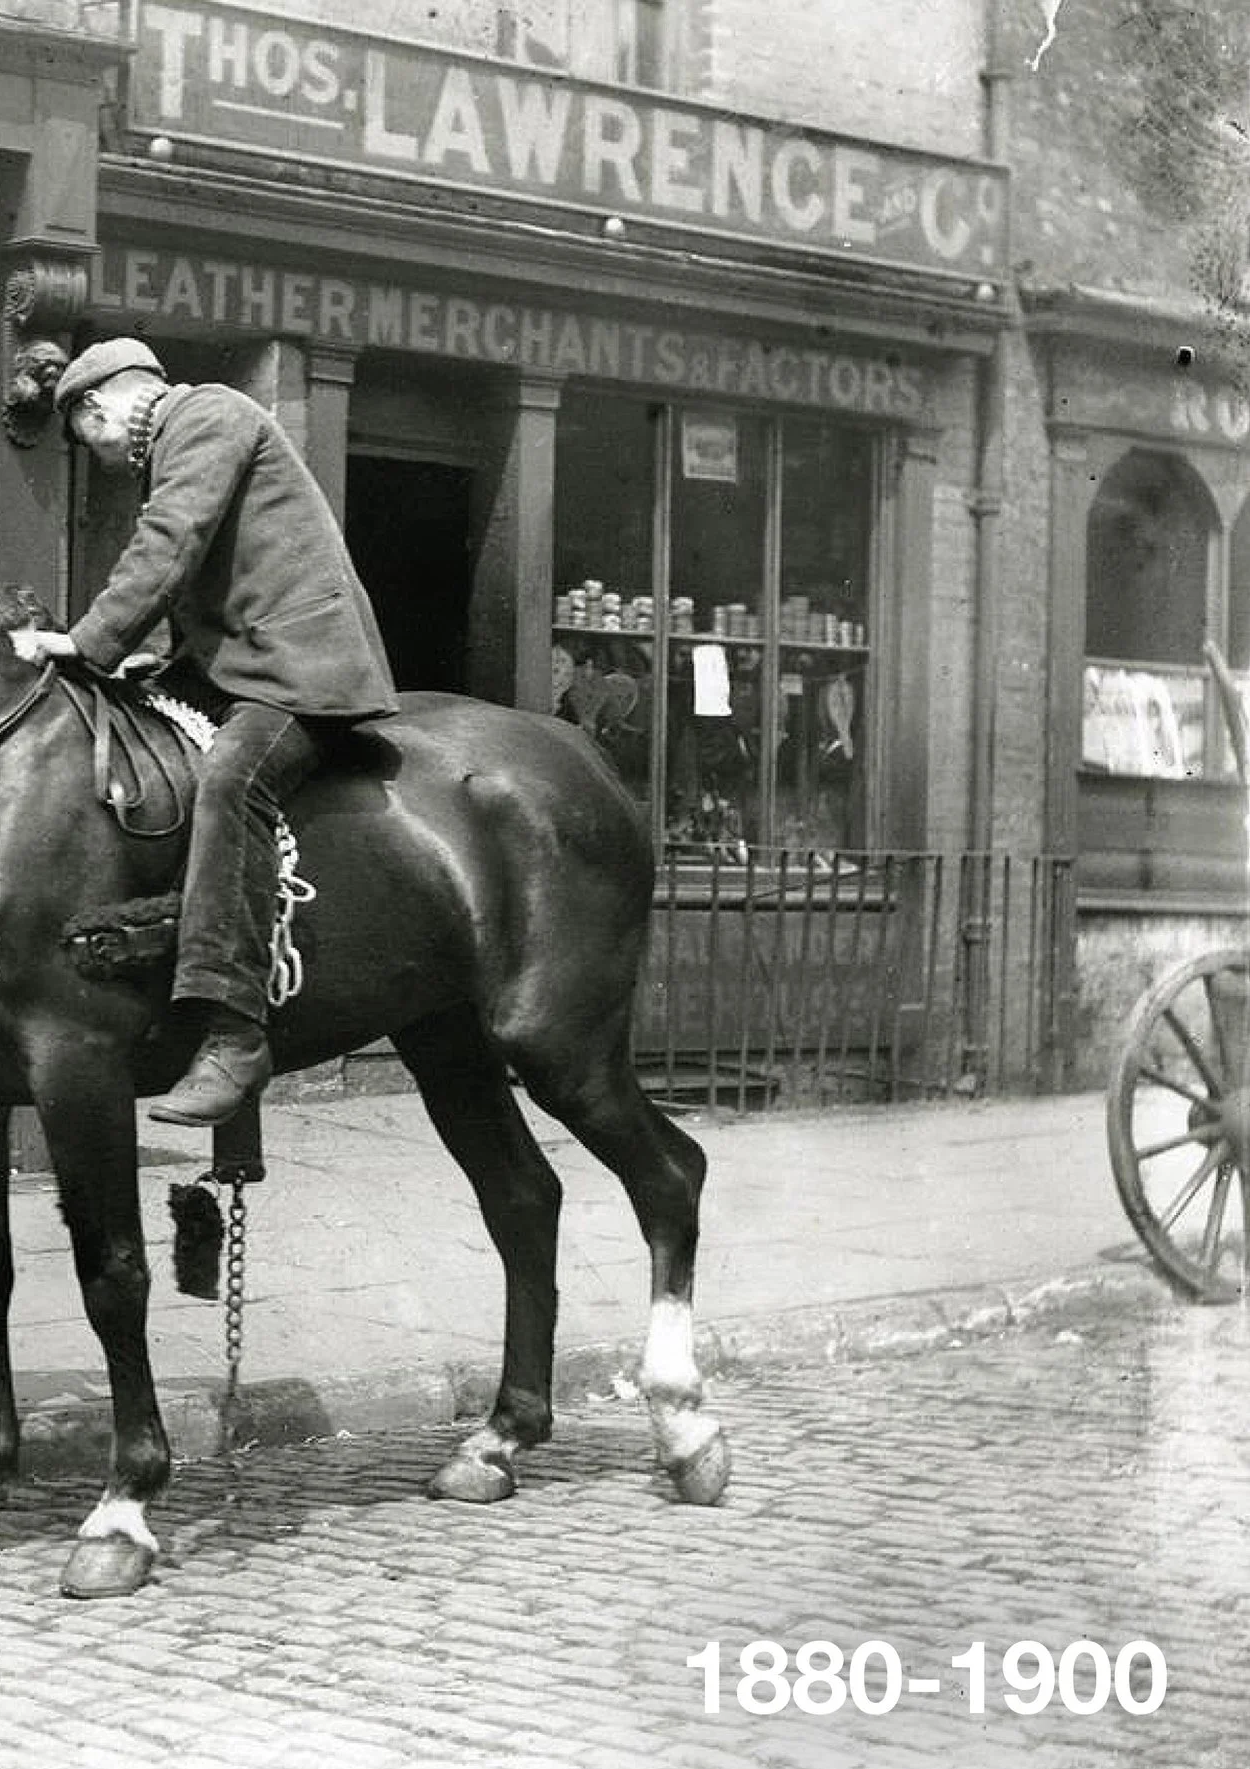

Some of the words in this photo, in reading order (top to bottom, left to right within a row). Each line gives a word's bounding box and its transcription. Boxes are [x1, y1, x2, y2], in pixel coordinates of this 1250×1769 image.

[363, 48, 877, 245] LAWRENCE
[90, 250, 354, 339] LEATHER
[368, 286, 686, 383] MERCHANTS
[716, 340, 924, 414] FACTORS
